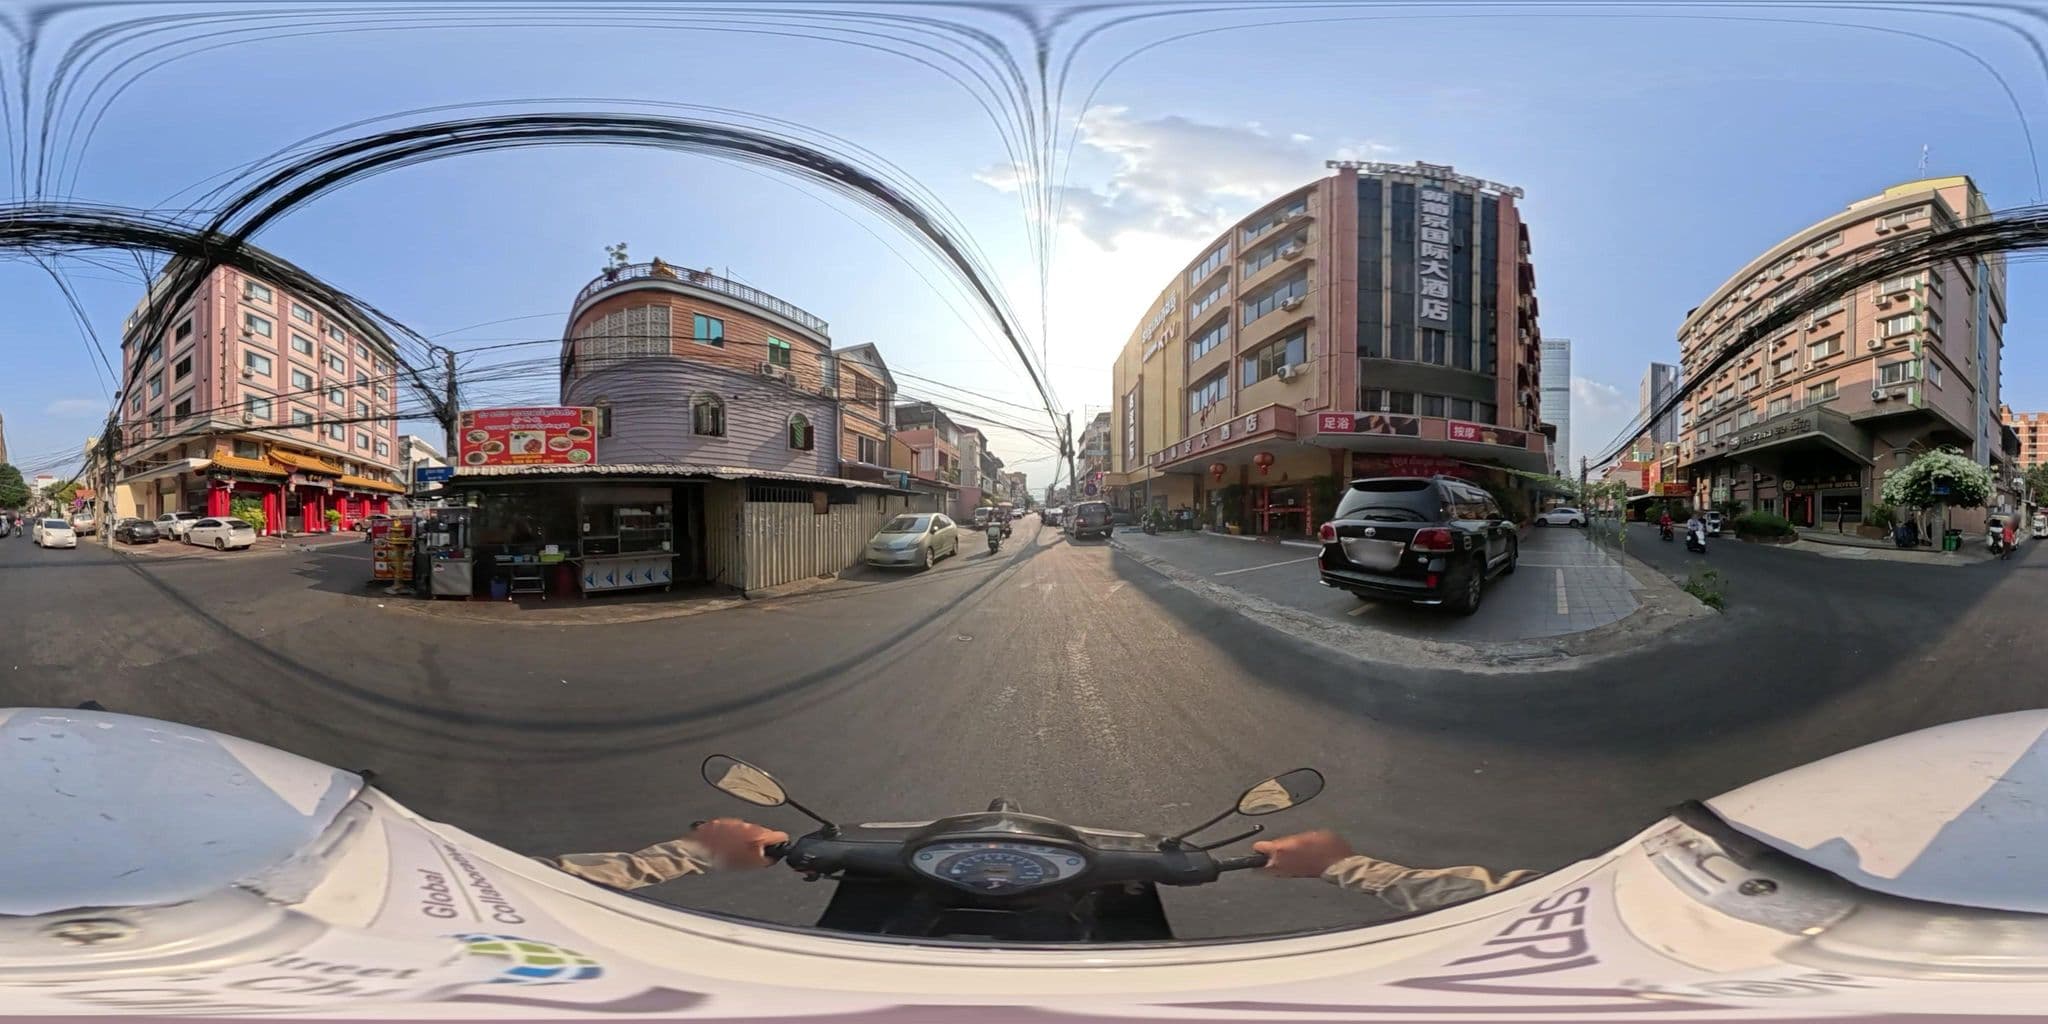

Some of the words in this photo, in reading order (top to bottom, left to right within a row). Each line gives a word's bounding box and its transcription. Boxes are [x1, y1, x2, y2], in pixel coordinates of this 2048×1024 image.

[1324, 416, 1350, 430] 足浴
[1454, 426, 1475, 439] 按摩
[417, 868, 459, 919] Global
